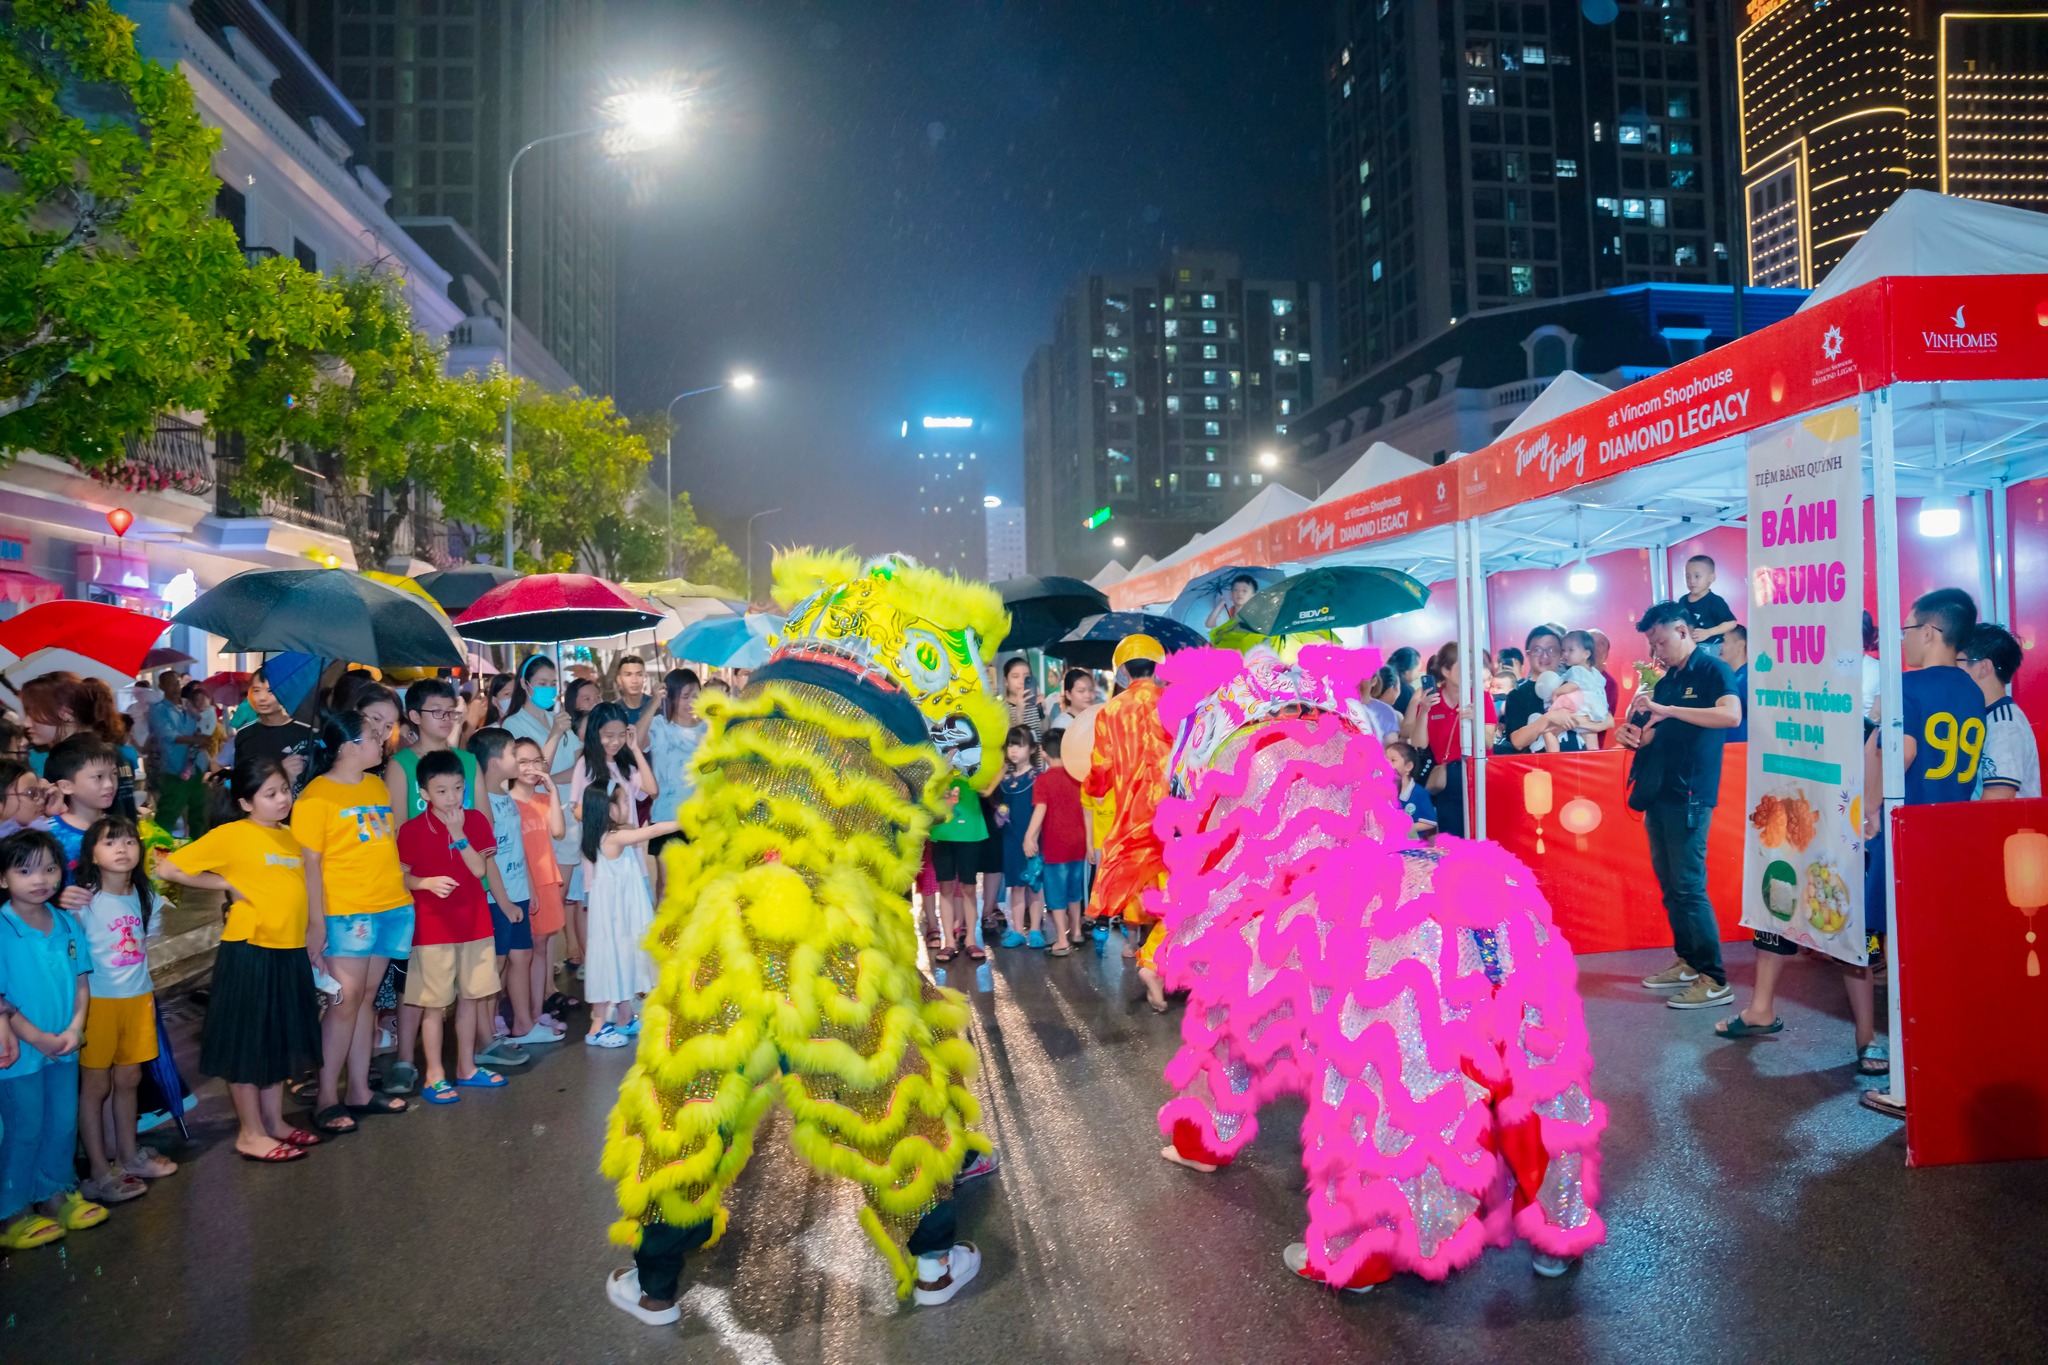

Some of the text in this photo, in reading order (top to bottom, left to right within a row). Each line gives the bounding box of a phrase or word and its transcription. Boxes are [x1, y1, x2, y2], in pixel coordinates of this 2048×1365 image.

[1921, 331, 1998, 348] VINHOMES
[1608, 368, 1733, 428] at Vincom Shophouse
[1599, 388, 1750, 464] DIAMOND LEGACY
[1514, 432, 1587, 482] Funny Friday
[1755, 469, 1778, 487] TIỆM
[1780, 465, 1806, 482] BÁNH
[1340, 510, 1409, 543] DIAMOND LEGACY
[1762, 494, 1837, 548] BÁNH
[1299, 609, 1320, 619] BIDV
[1772, 625, 1825, 665] THU
[1924, 711, 1986, 783] 99
[107, 915, 141, 932] LOTSO
